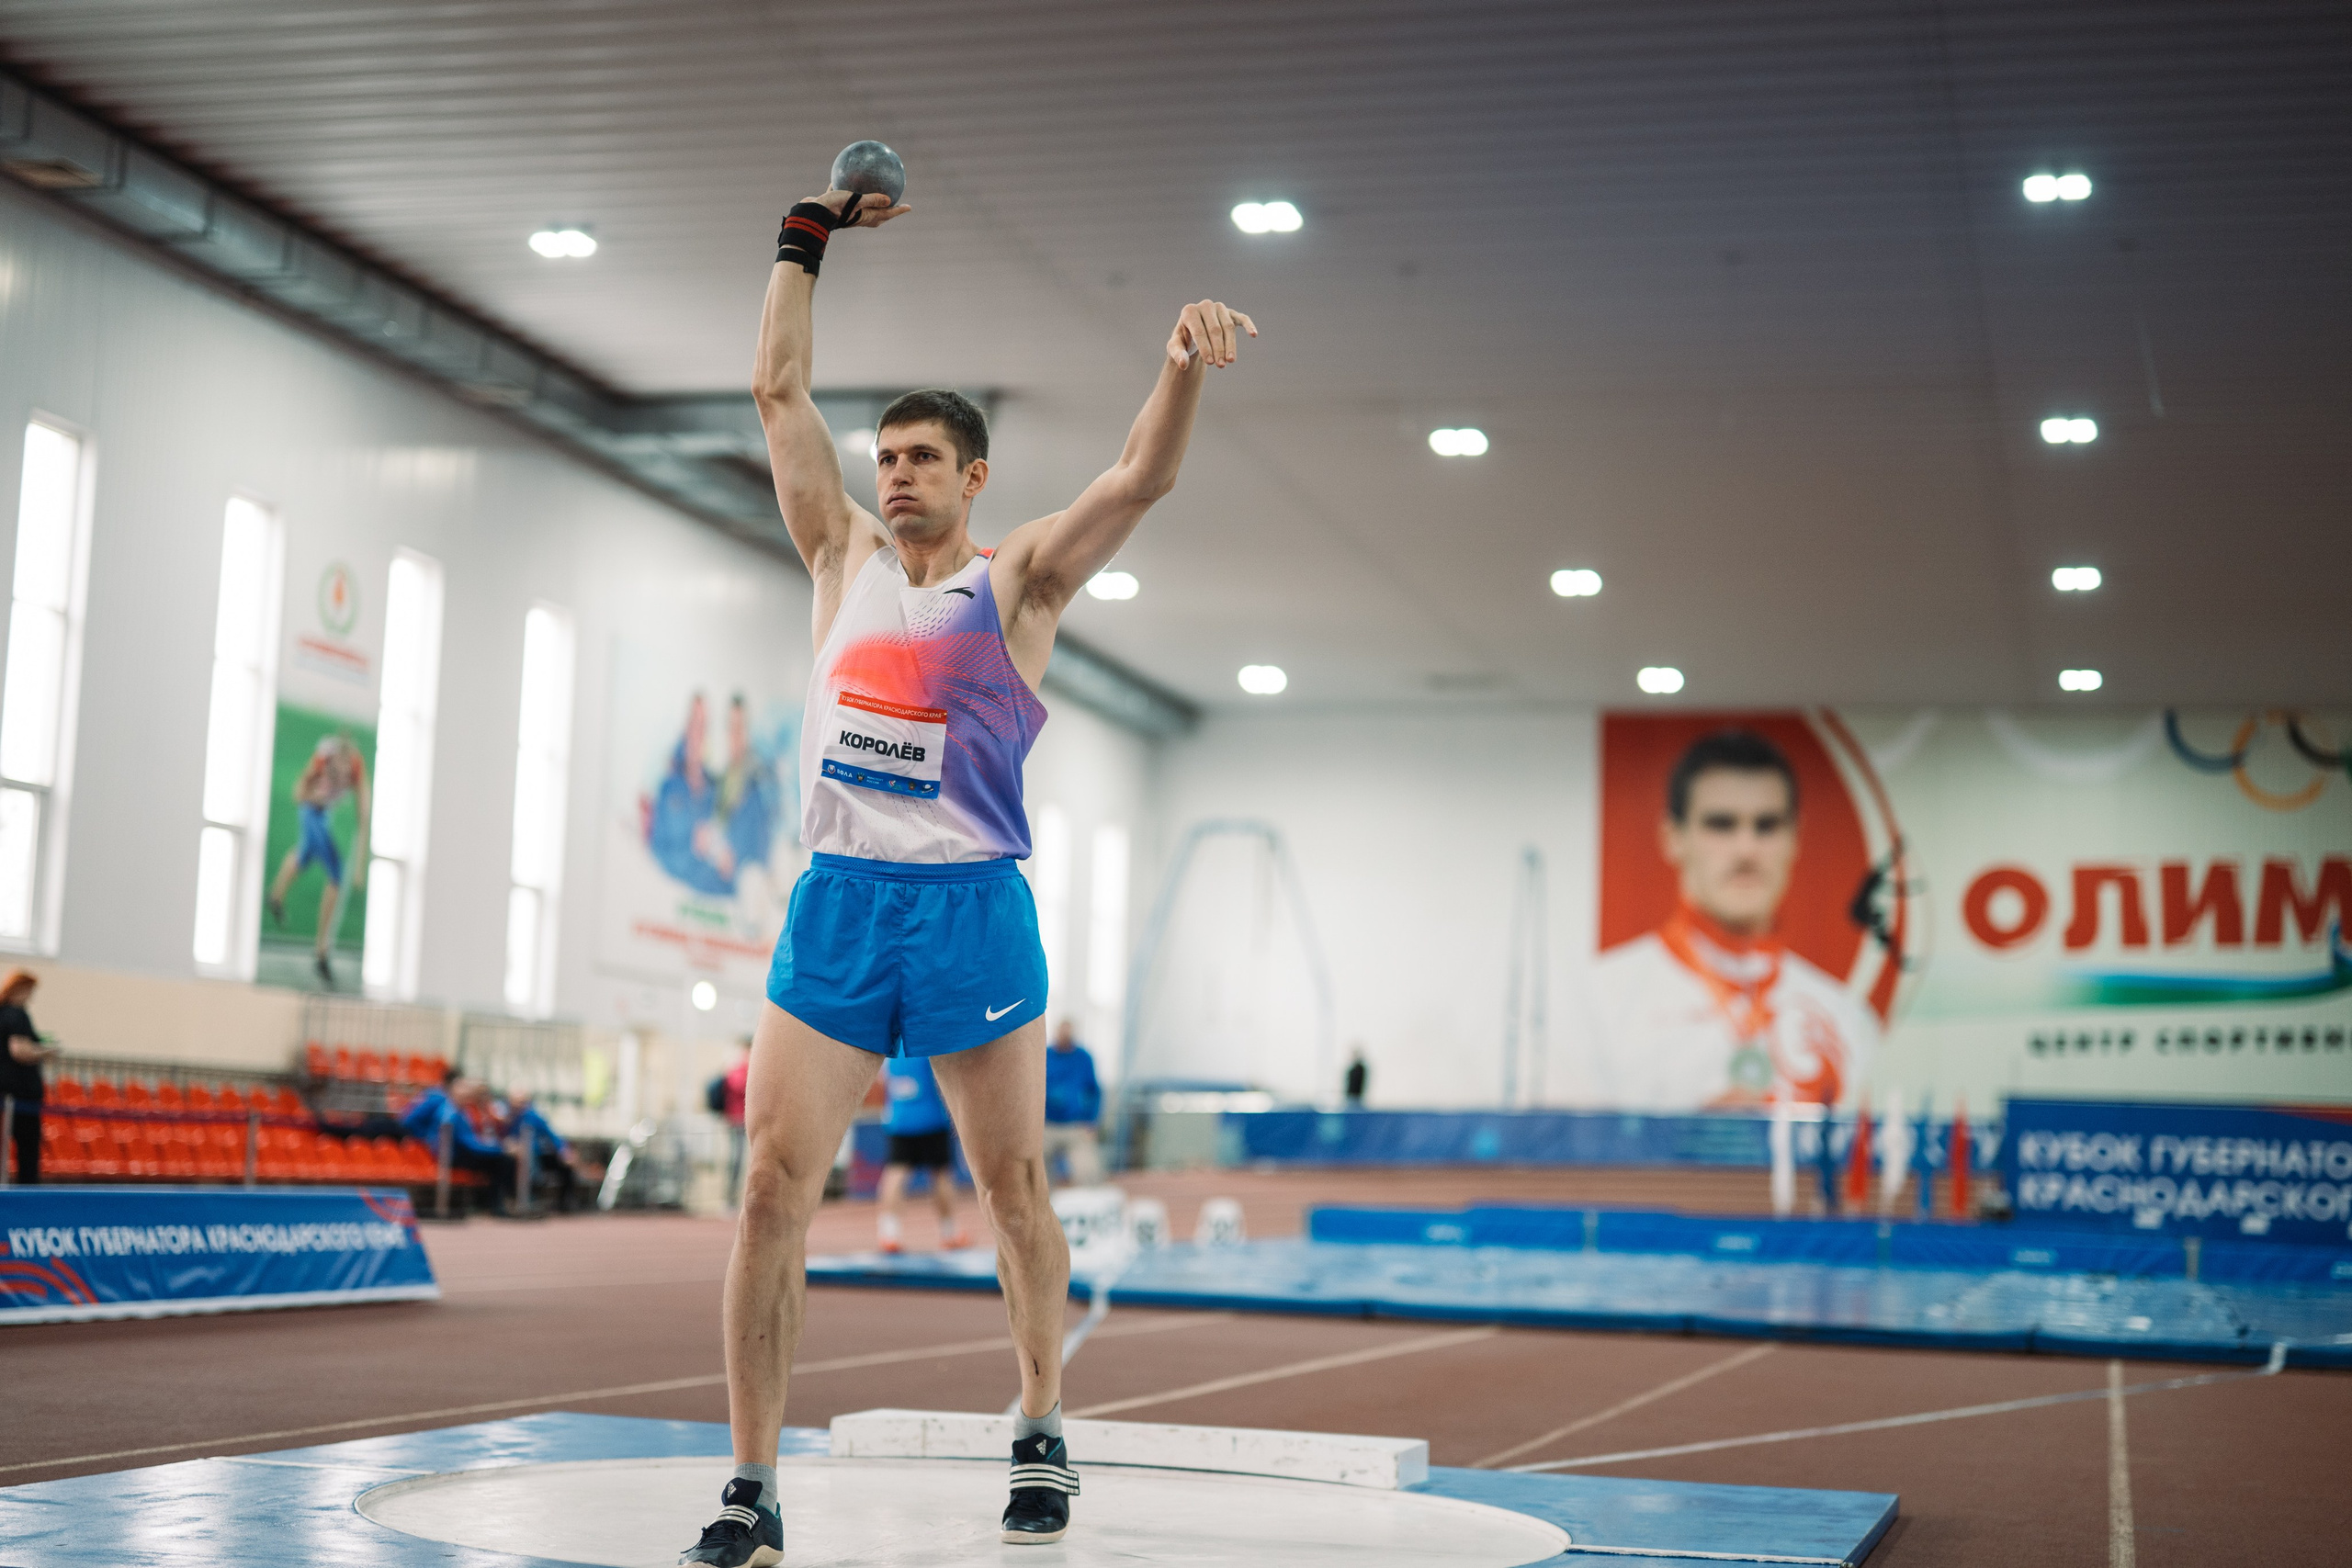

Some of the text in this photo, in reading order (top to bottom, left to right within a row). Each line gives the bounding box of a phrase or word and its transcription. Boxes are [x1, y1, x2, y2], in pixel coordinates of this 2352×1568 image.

[854, 698, 882, 710] ГУБЕРНАТОРА
[884, 705, 929, 718] КРАСНОДАРСКОГО
[929, 711, 942, 719] КРАЯ
[839, 730, 926, 762] КОРОЛЁВ
[2018, 1131, 2143, 1174] КУБОК
[7, 1227, 80, 1258] КУБОК
[78, 1224, 209, 1257] ГУБЕРНАТОРА
